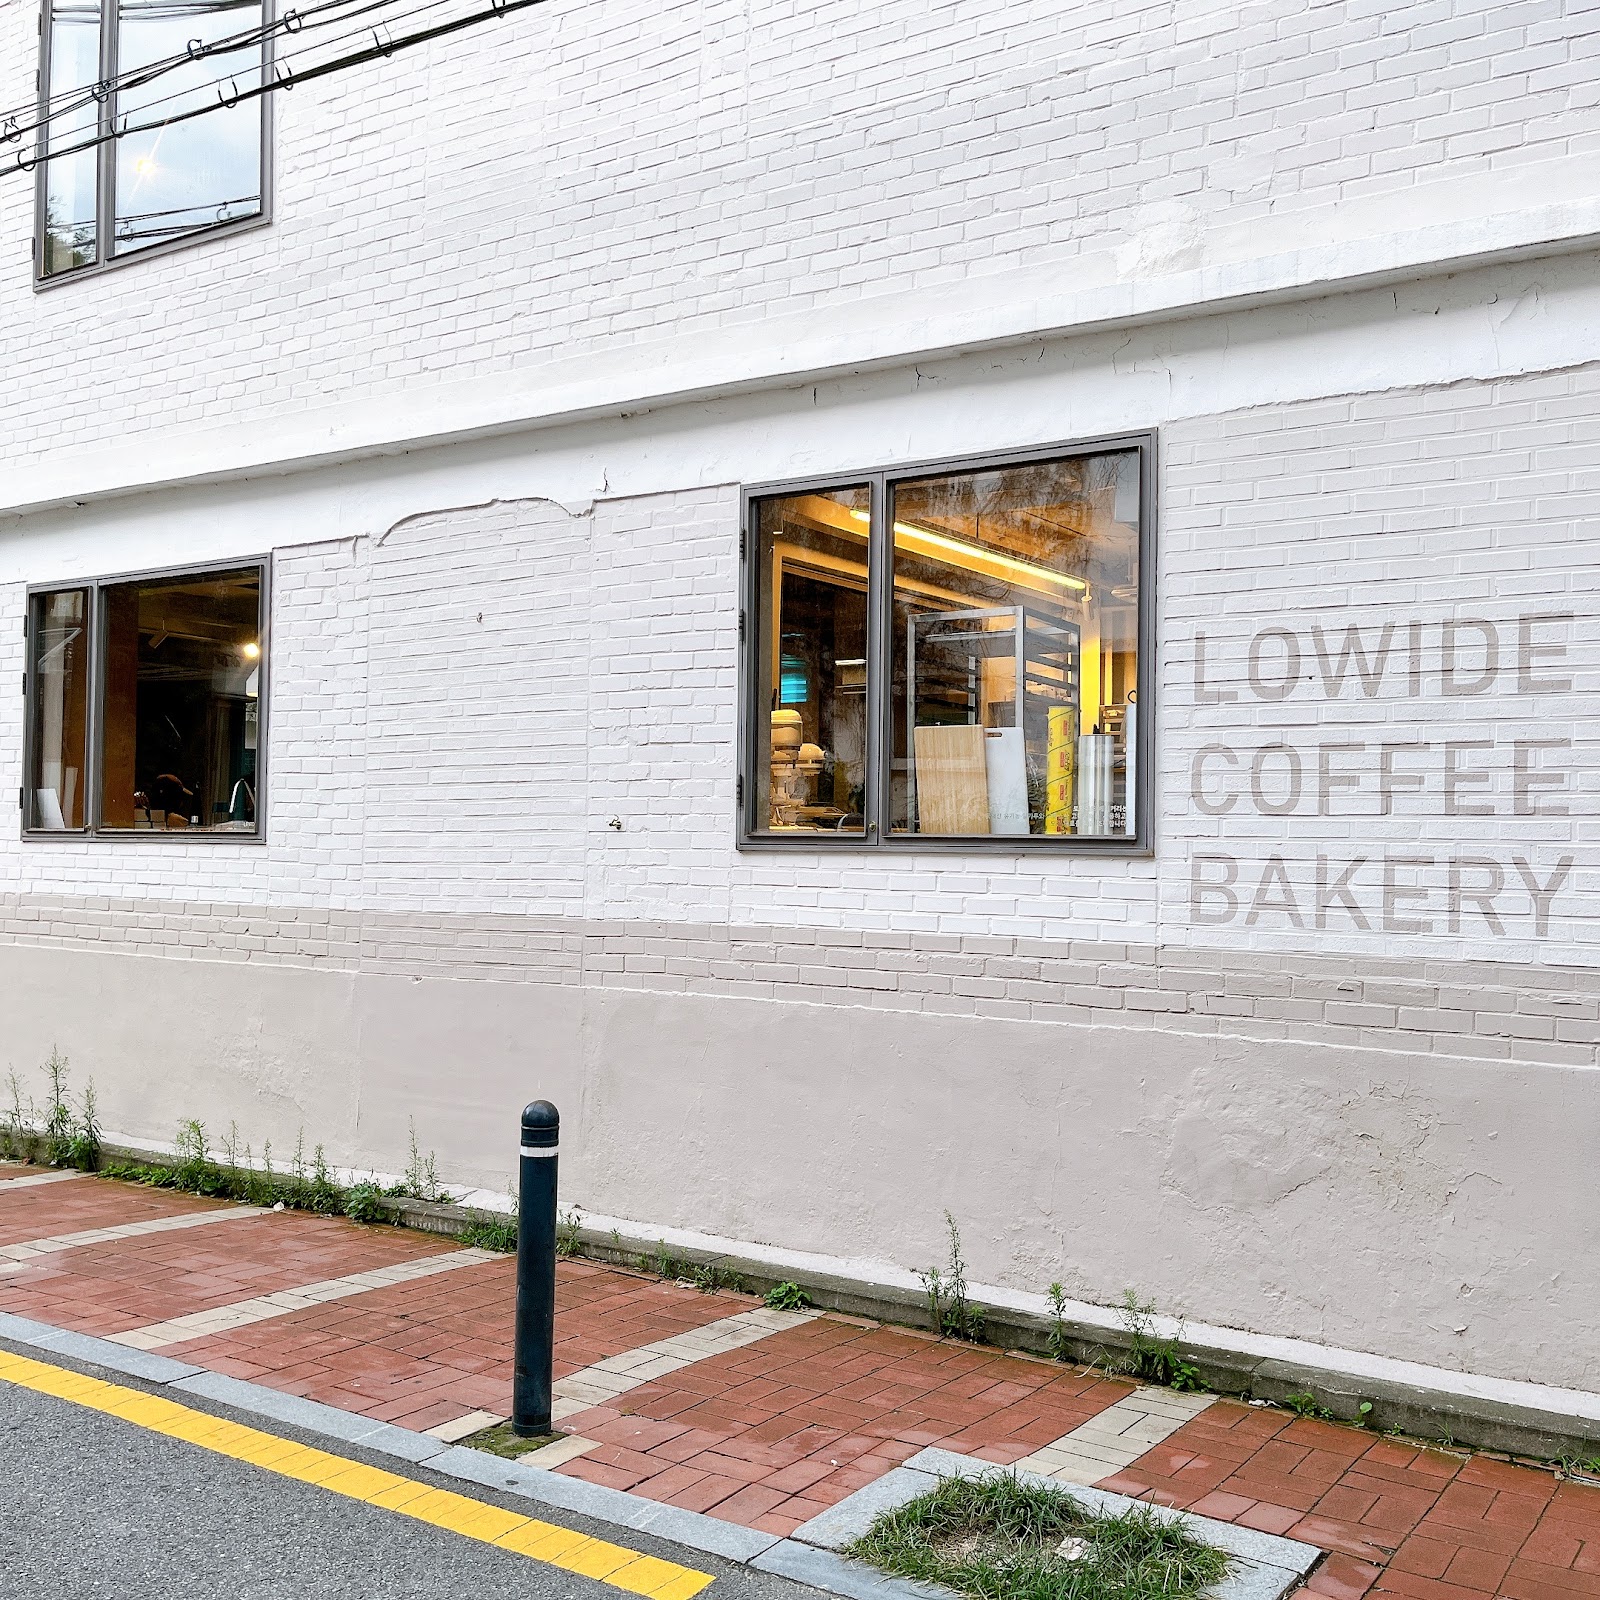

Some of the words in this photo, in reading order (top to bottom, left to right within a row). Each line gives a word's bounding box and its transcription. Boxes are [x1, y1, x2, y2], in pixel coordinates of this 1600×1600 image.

[1193, 610, 1574, 702] LOWIDE
[1191, 738, 1572, 816] COFFEE
[1189, 851, 1575, 937] BAKERY
